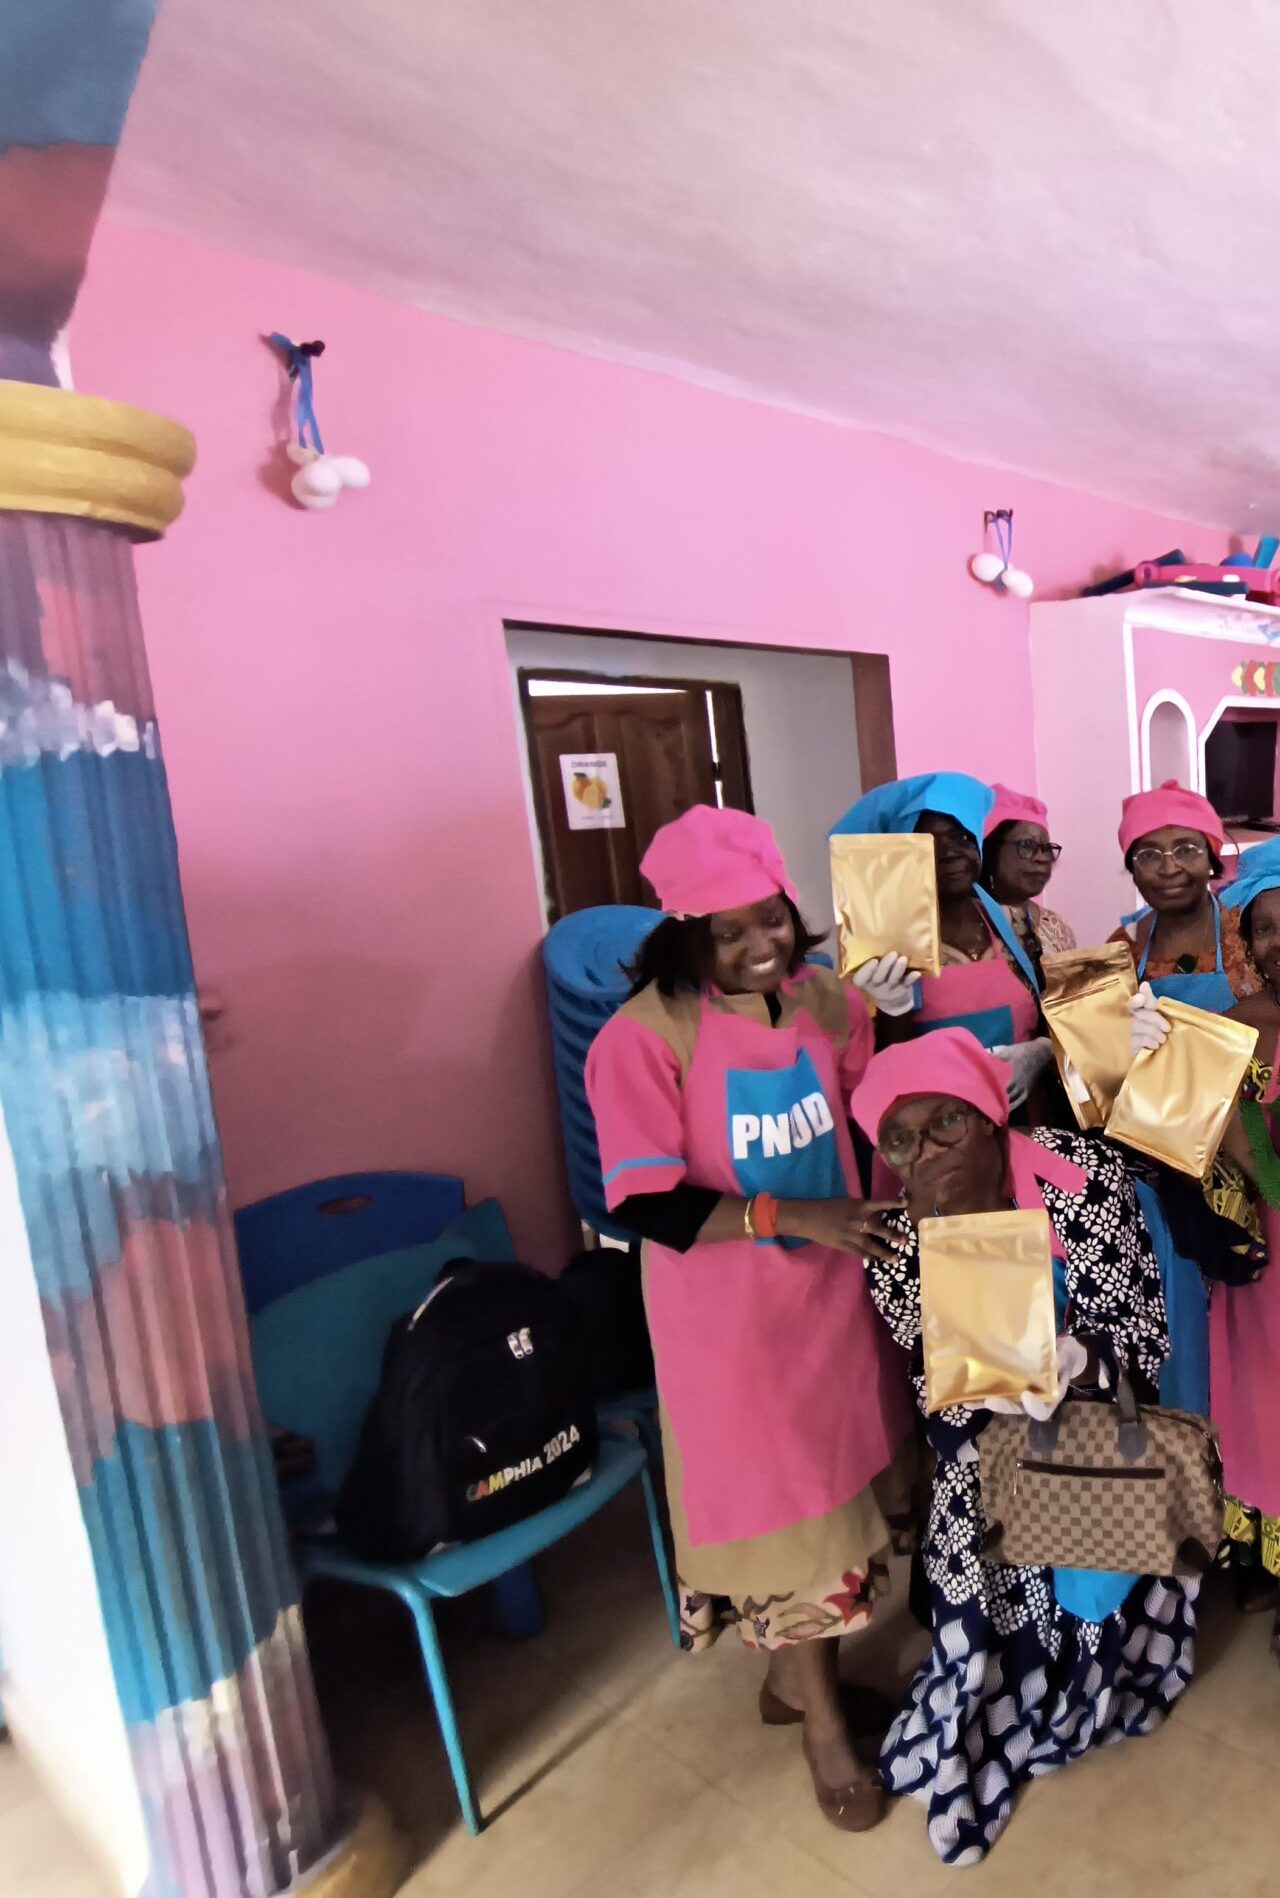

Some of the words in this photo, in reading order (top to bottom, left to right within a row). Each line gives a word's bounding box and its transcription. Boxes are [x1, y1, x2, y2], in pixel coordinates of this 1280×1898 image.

[732, 1091, 834, 1160] PNUD
[466, 1455, 544, 1502] CAMPHIA
[543, 1423, 581, 1465] 2024
